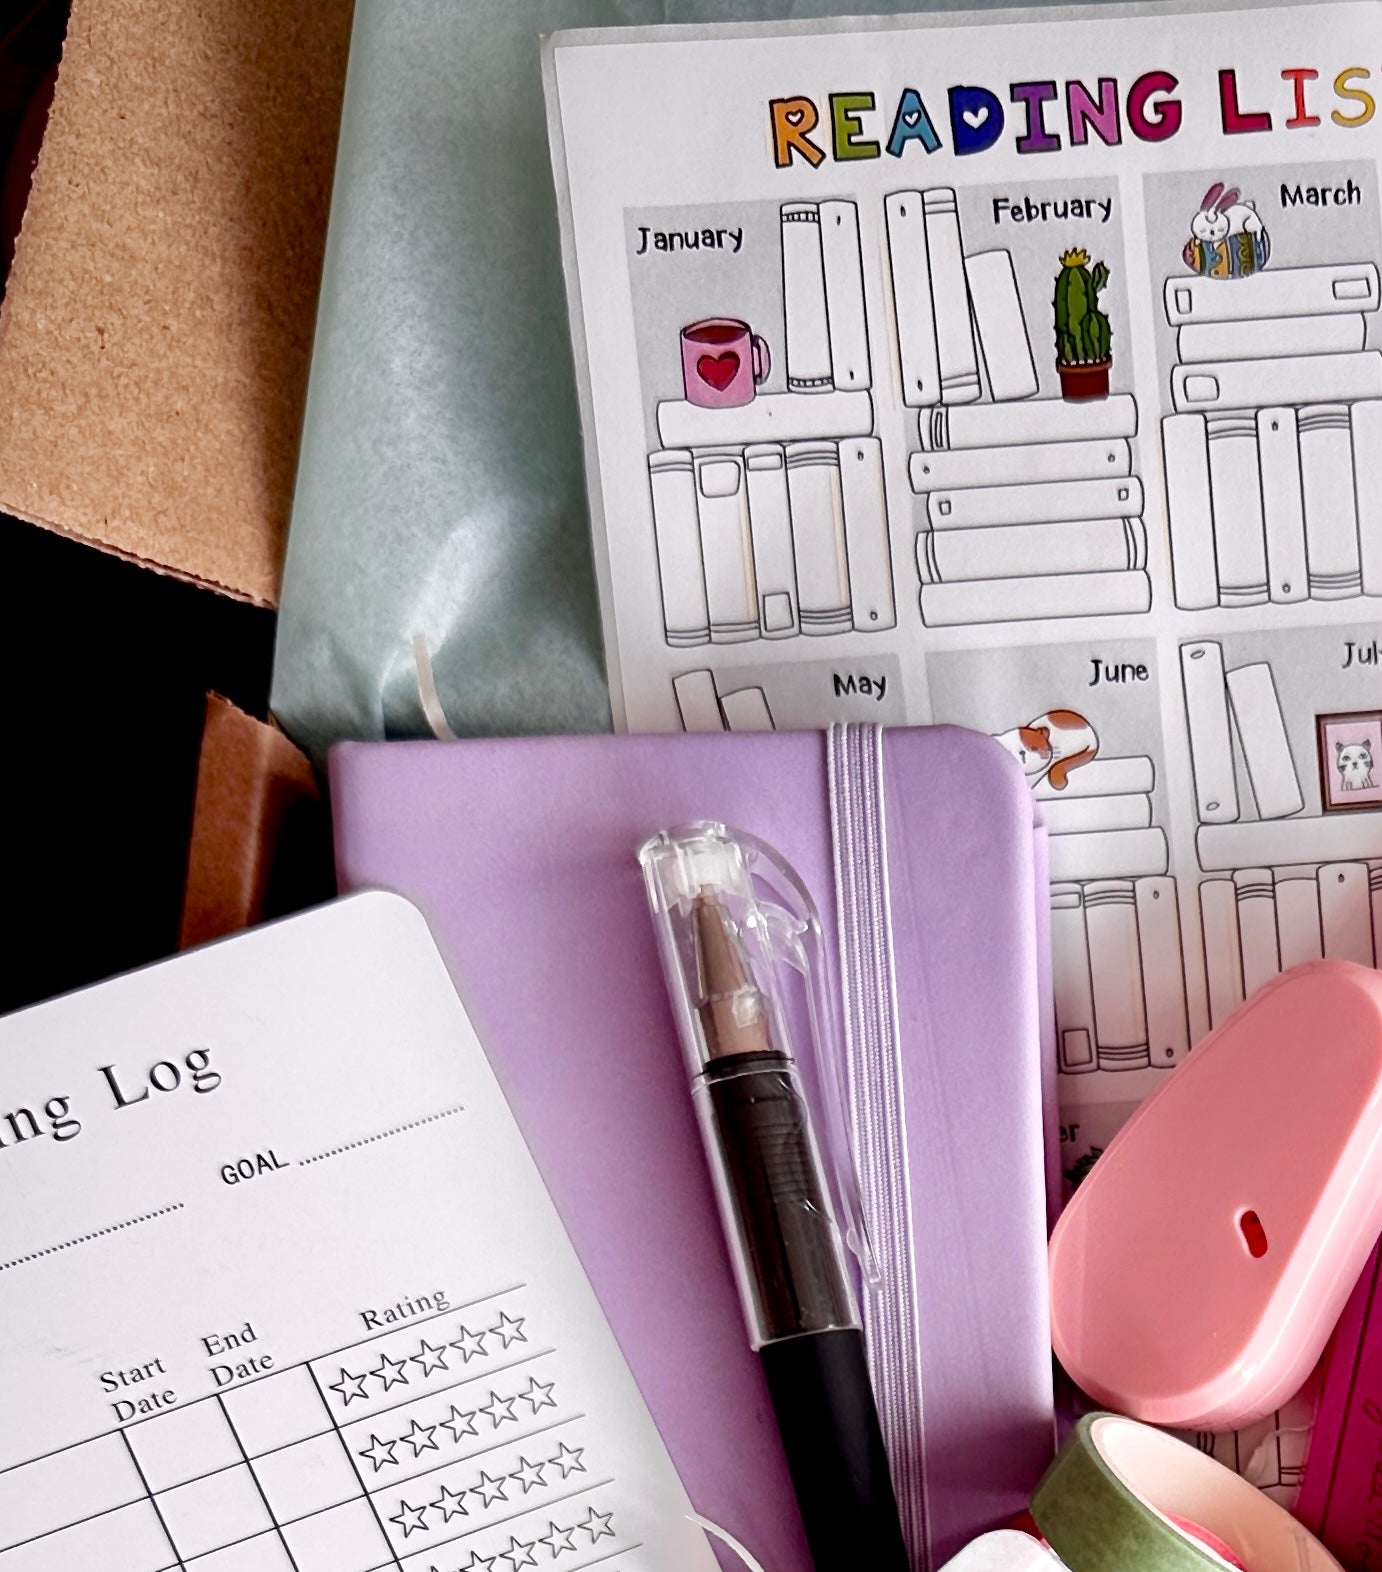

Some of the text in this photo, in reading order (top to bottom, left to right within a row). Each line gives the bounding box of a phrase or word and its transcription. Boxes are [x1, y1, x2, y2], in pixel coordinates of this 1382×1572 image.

[768, 70, 1182, 168] READING
[993, 197, 1112, 225] February
[1280, 180, 1361, 208] March
[636, 226, 743, 255] January
[833, 672, 888, 701] May
[1089, 659, 1149, 687] June
[98, 1046, 222, 1110] Log
[220, 1149, 289, 1186] GOAL
[358, 1286, 451, 1333] Rating
[201, 1321, 259, 1359] End
[99, 1355, 167, 1394] Start
[209, 1350, 275, 1389] Date
[111, 1385, 178, 1423] Date
